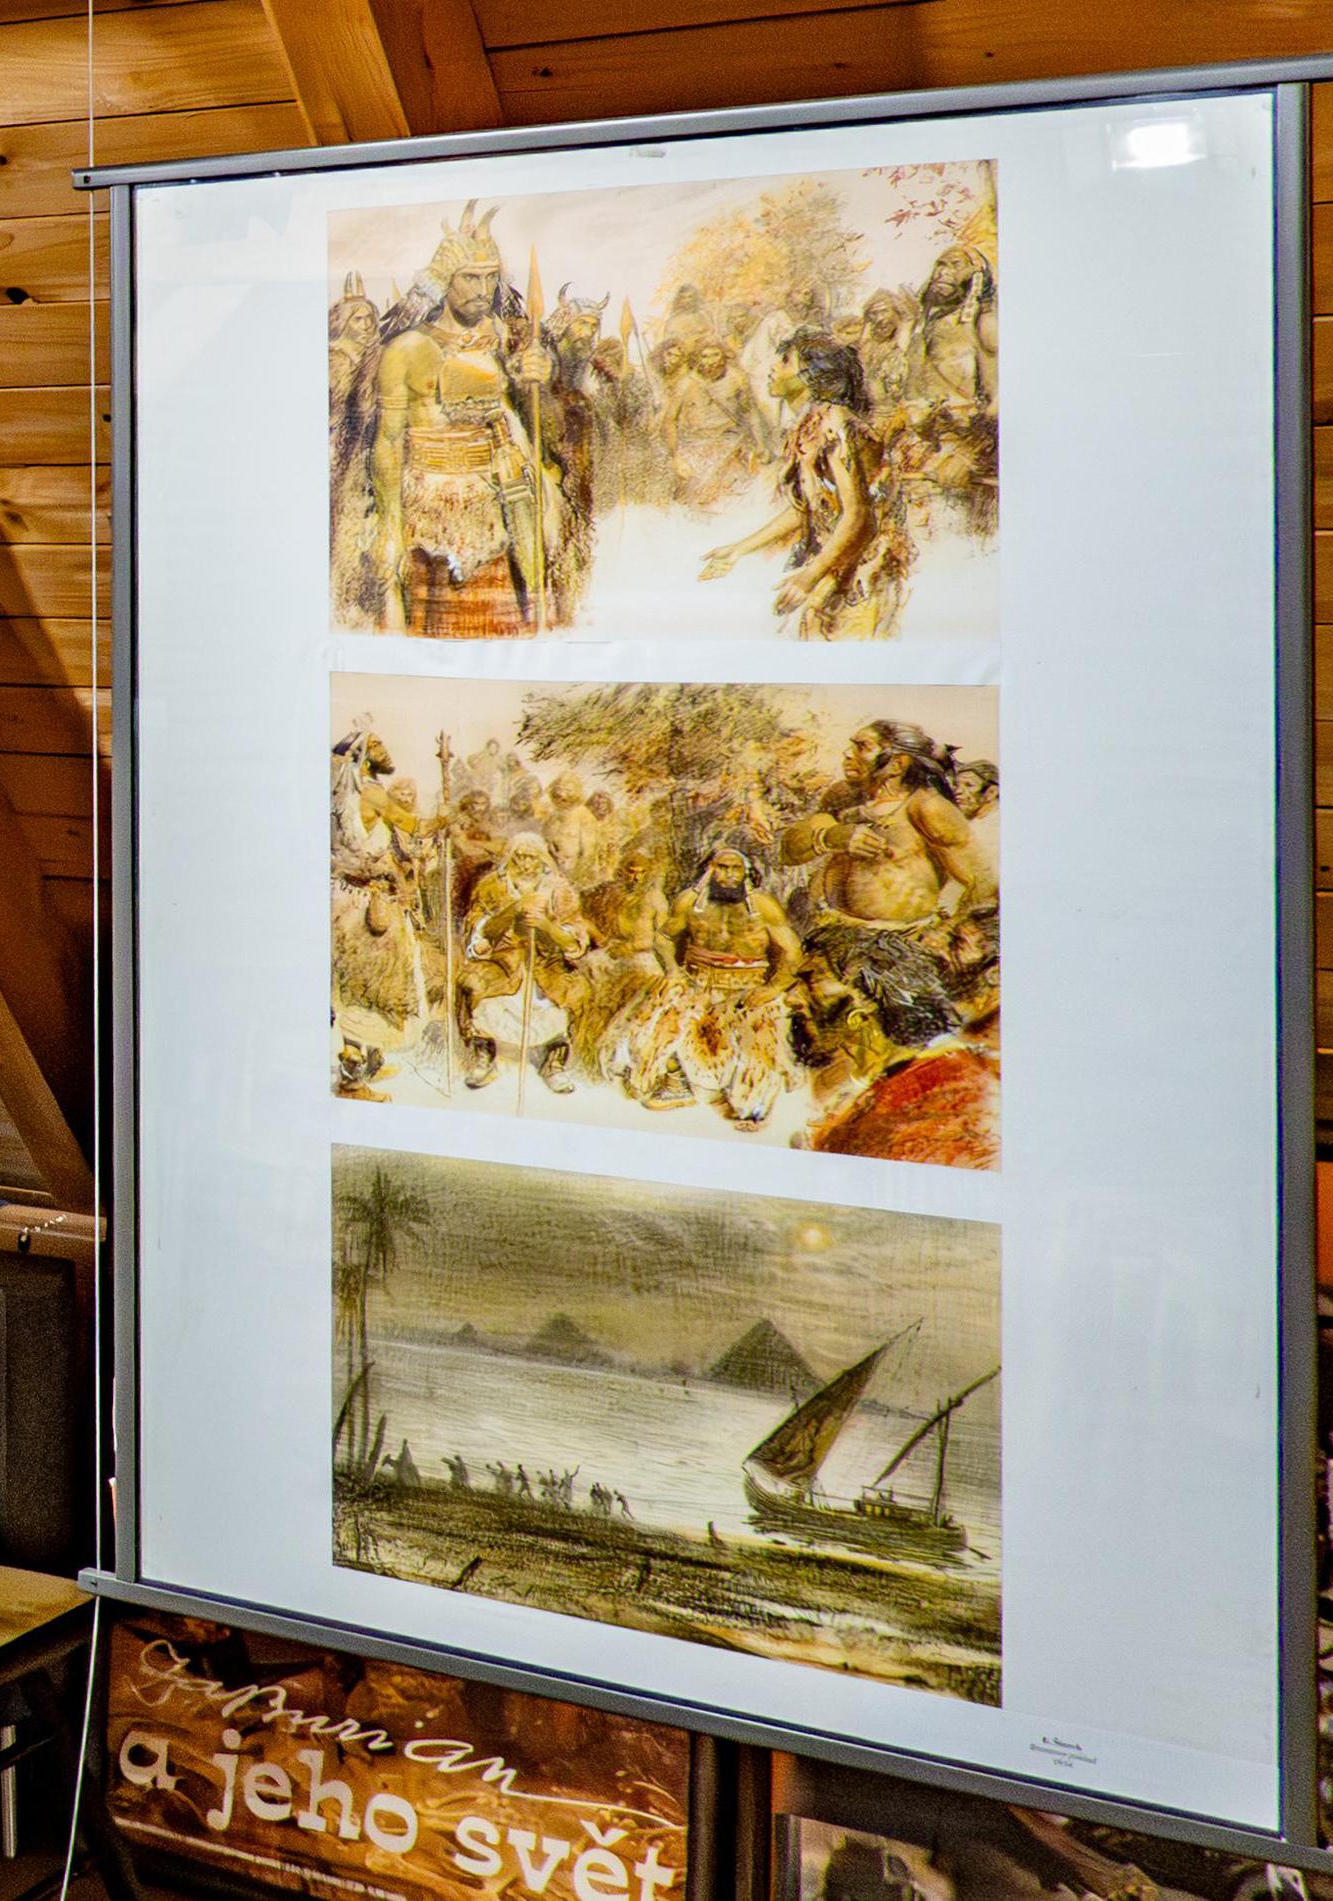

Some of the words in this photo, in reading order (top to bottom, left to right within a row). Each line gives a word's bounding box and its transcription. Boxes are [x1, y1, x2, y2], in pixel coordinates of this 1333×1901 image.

[119, 1730, 182, 1791] a
[207, 1728, 418, 1854] jeho
[453, 1816, 677, 1901] svět
